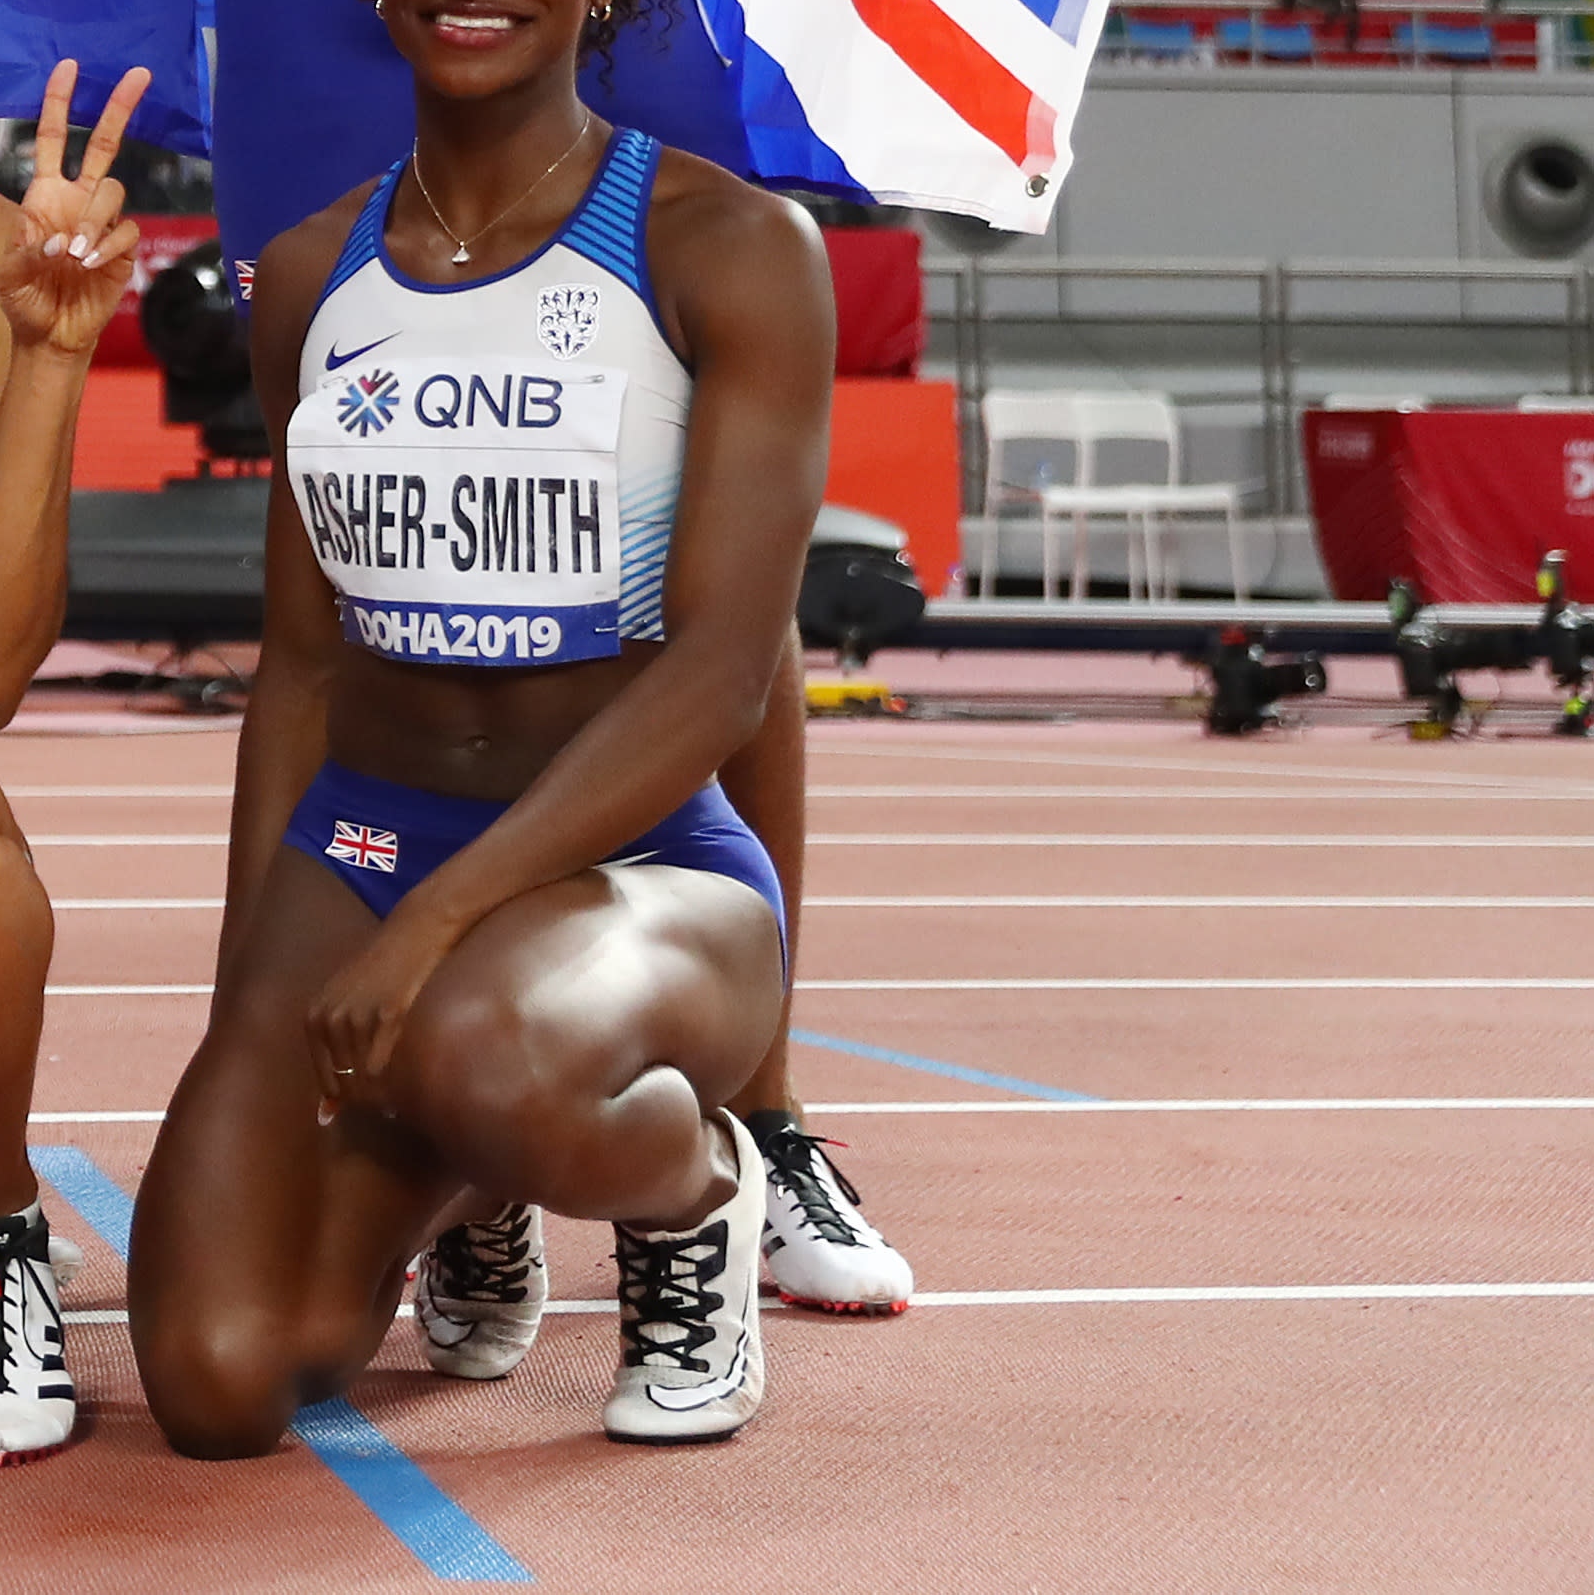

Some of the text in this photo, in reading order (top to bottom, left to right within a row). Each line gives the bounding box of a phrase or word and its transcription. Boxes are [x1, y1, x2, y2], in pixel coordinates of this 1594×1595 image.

[413, 374, 564, 429] QNB
[302, 473, 602, 575] ASHER-SMITH
[354, 607, 562, 659] DOHA2019
